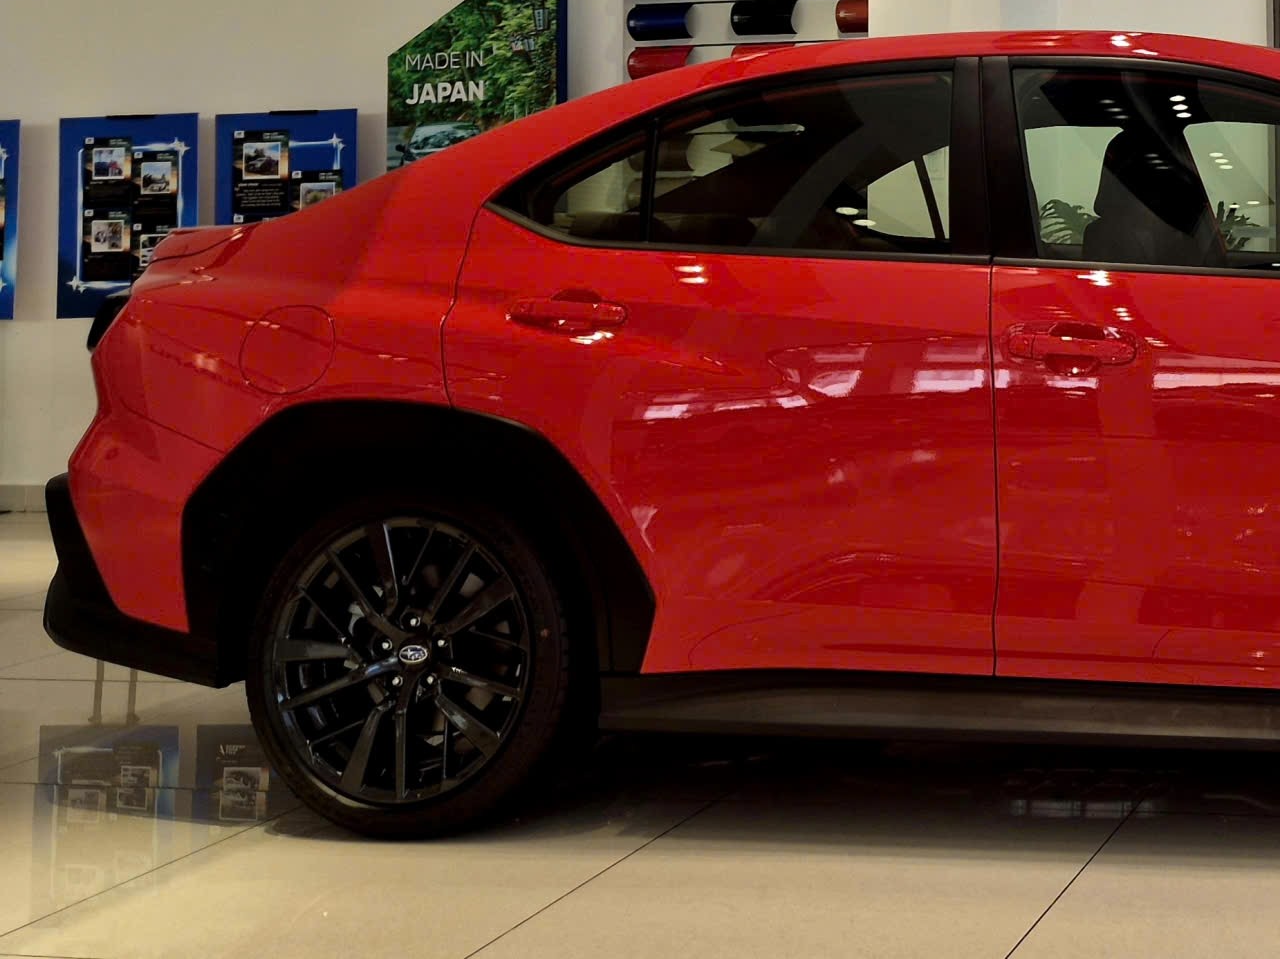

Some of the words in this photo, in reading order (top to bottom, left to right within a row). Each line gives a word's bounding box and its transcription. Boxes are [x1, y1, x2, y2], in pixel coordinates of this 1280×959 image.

[405, 51, 461, 72] MADE
[465, 49, 484, 68] IN
[405, 80, 485, 104] JAPAN
